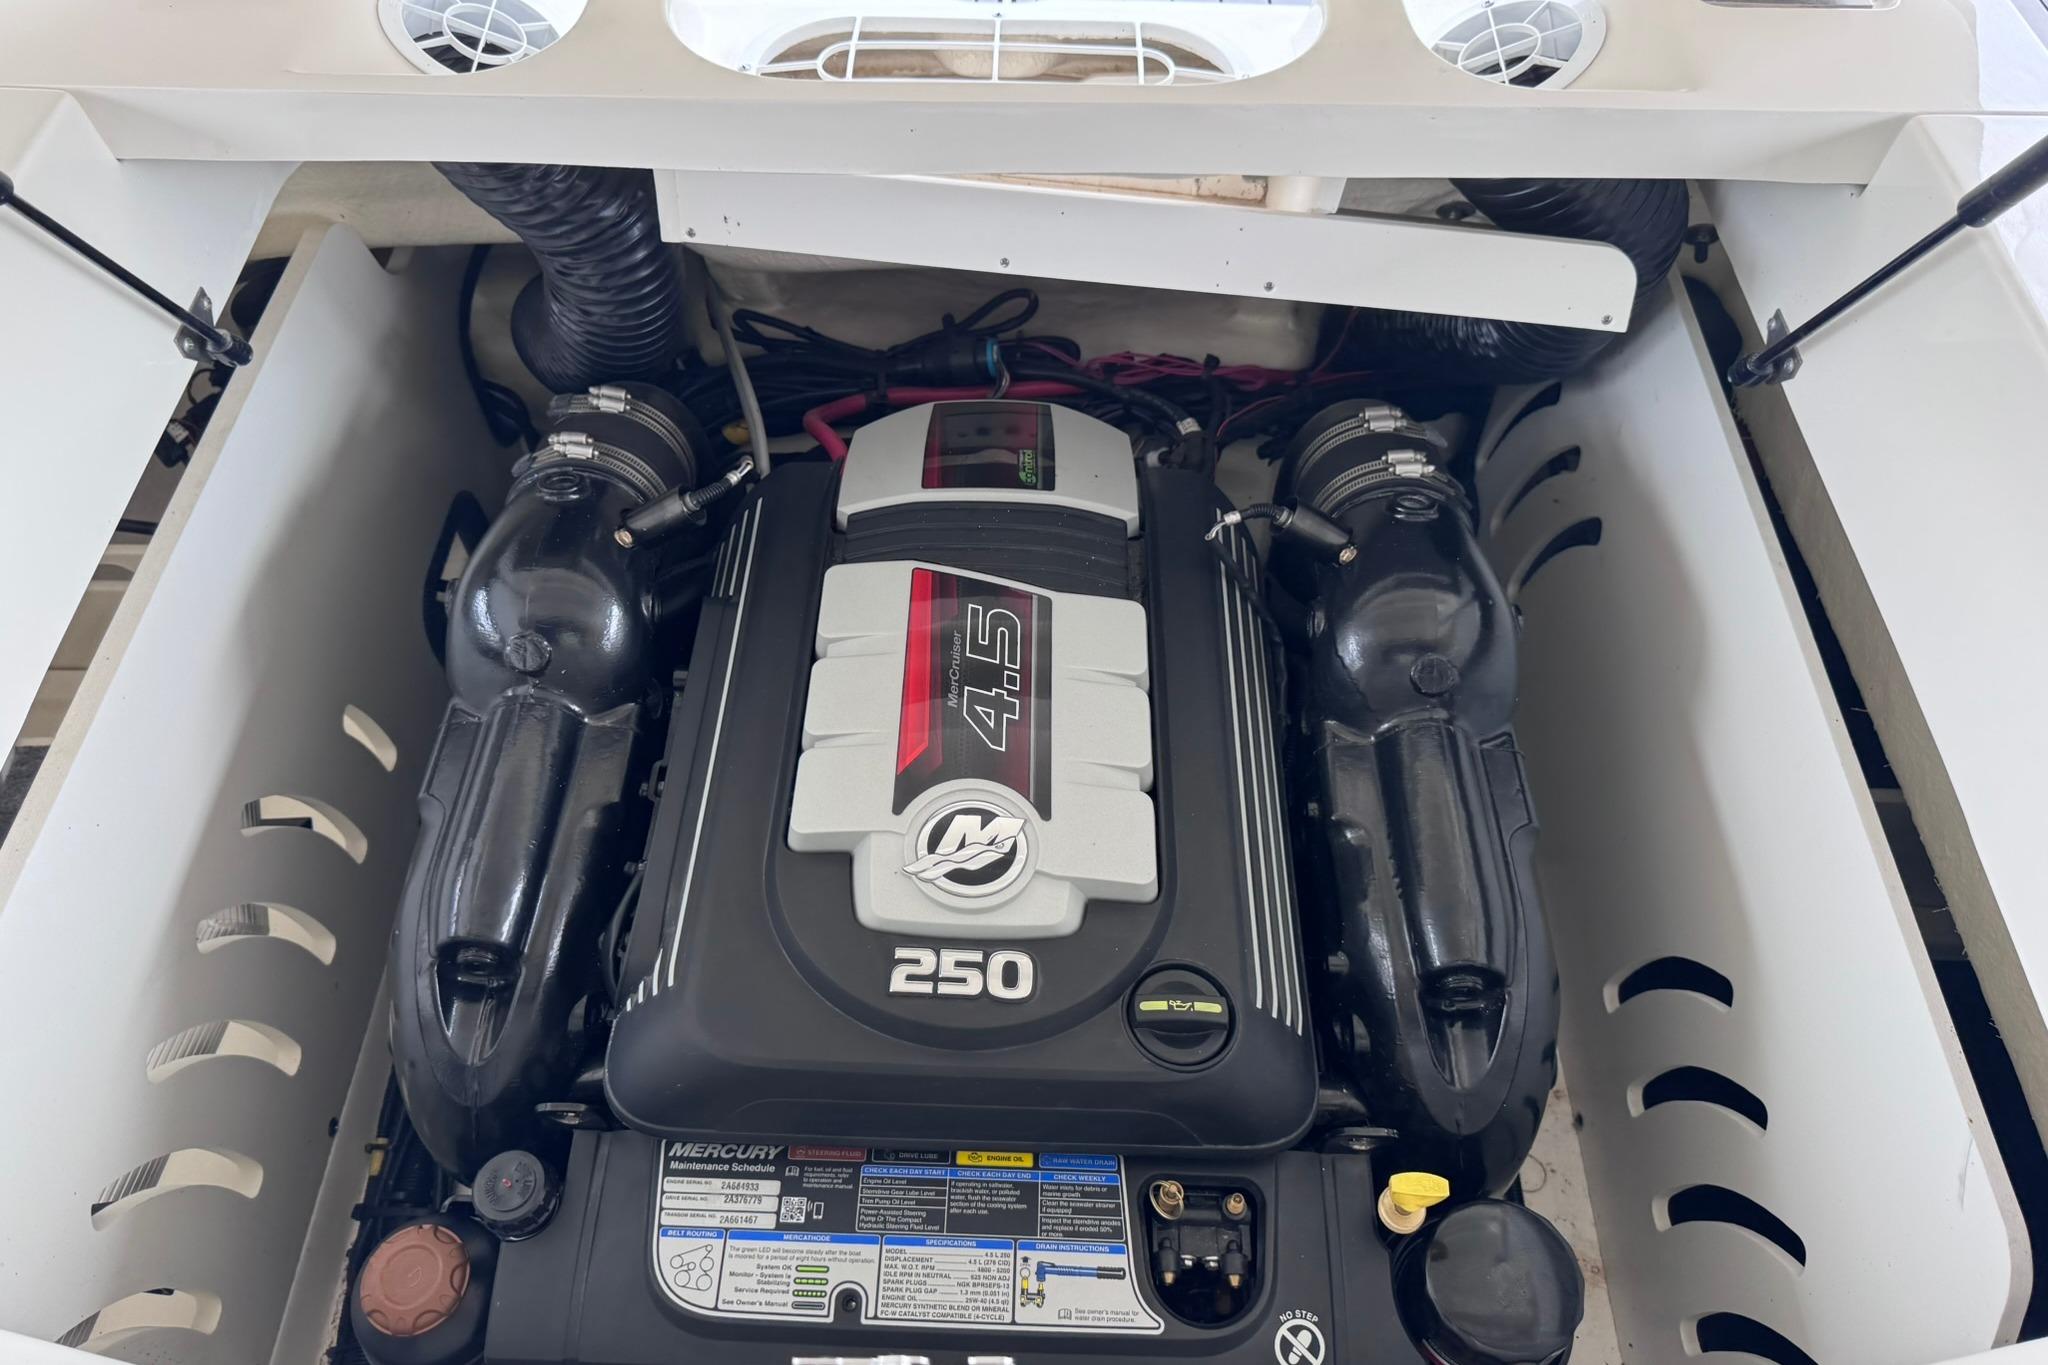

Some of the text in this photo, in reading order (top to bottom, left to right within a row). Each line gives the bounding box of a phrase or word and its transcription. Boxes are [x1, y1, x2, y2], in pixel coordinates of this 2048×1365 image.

[948, 630, 962, 708] MerCruiser
[963, 603, 1021, 752] 4.5
[889, 947, 1034, 1000] 250
[668, 1143, 784, 1159] MERCURY
[670, 1161, 776, 1173] Maintenance Schedule
[1280, 1310, 1319, 1323] NO STEP
